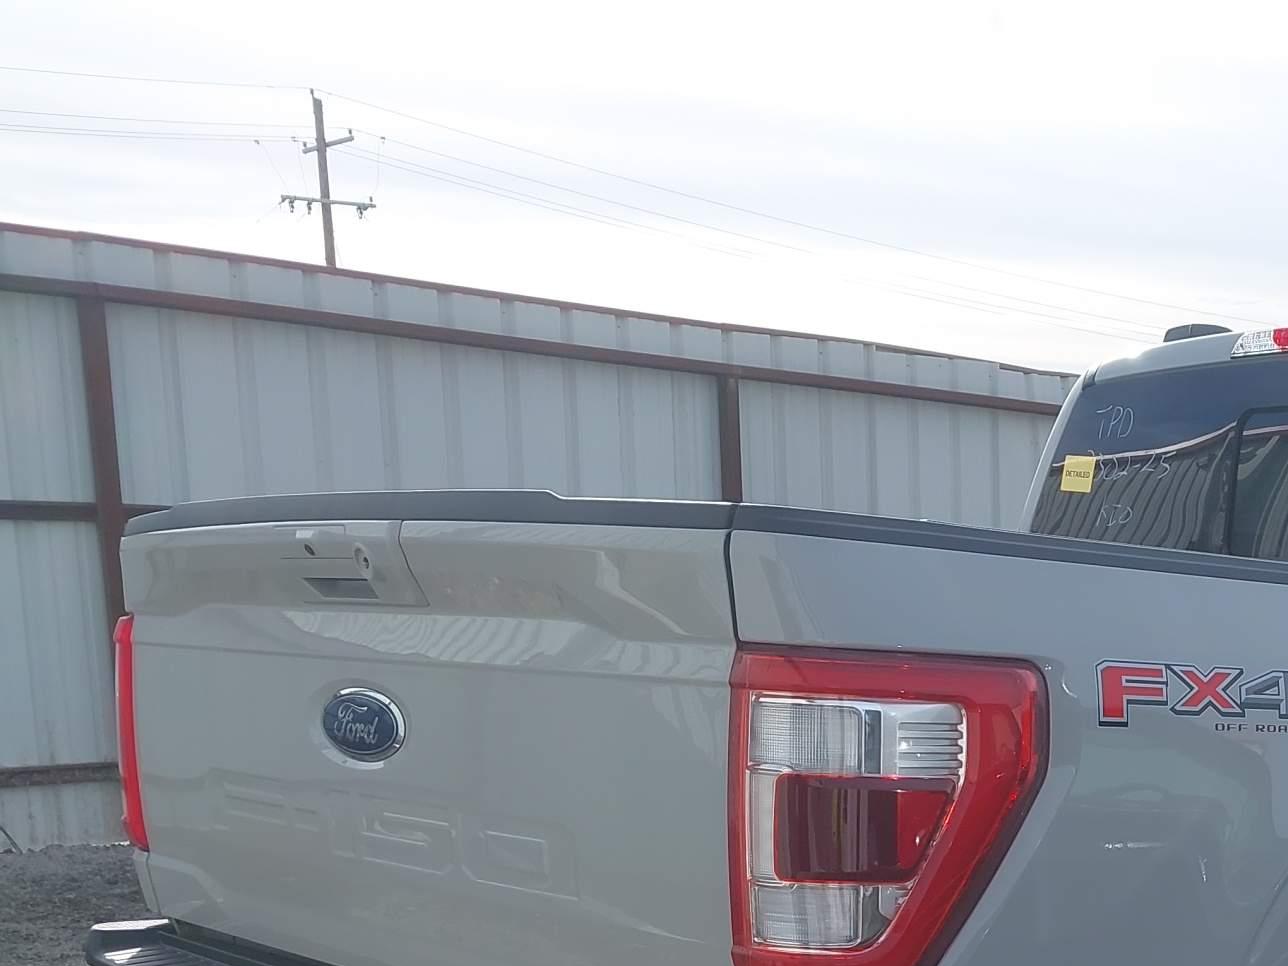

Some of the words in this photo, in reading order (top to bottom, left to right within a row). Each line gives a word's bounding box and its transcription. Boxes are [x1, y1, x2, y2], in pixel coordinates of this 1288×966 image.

[1095, 404, 1134, 440] TPD
[1065, 469, 1091, 479] DETAILED
[334, 702, 379, 745] Ford
[1215, 722, 1248, 732] OFF
